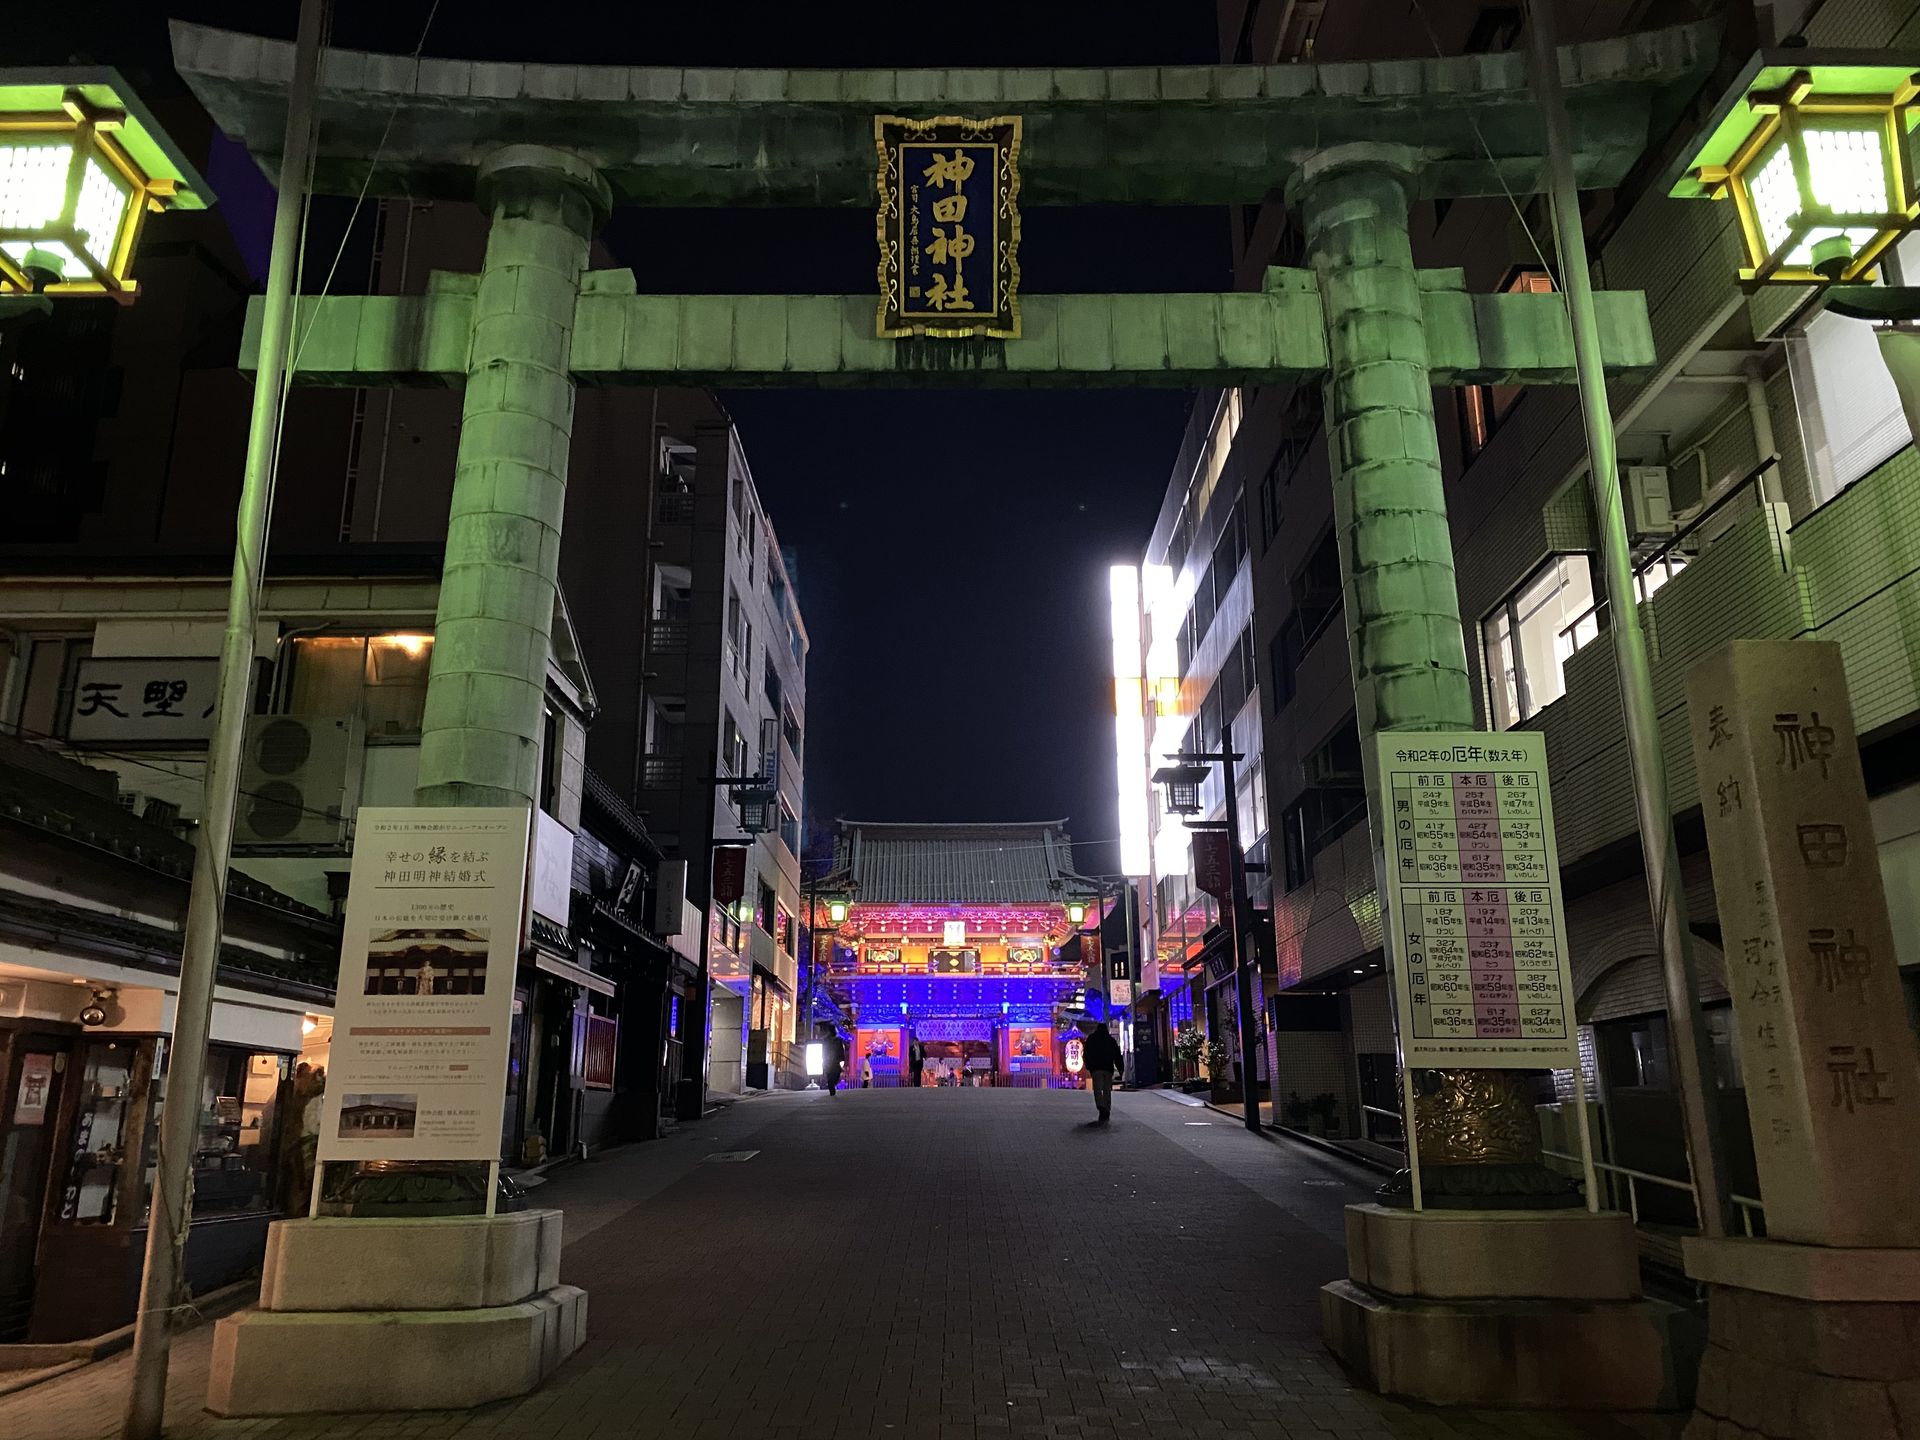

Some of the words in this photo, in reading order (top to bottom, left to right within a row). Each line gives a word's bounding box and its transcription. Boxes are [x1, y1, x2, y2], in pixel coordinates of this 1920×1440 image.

[924, 149, 975, 311] 神田神社
[78, 680, 215, 718] 天野
[1396, 746, 1528, 762] 令和2年の厄年(数え年)
[1418, 776, 1445, 786] 前厄
[1460, 776, 1487, 786] 本厄
[1502, 775, 1530, 785] 後厄
[1418, 800, 1450, 808] 平成9年生
[1460, 800, 1492, 808] 平成8年生
[1503, 799, 1534, 808] 平成7年生
[1397, 800, 1414, 869] 男の厄年
[1417, 831, 1455, 839] 昭和55年生
[1460, 831, 1498, 839] 昭和54年生
[1503, 831, 1540, 839] 昭和53年生
[386, 846, 489, 864] 幸せの縁を結ぶ
[1420, 863, 1458, 871] 昭和36年生
[1463, 863, 1501, 871] 昭和35年生
[1506, 863, 1544, 871] 昭和34年生
[384, 870, 486, 882] 神田明神結婚式
[1428, 891, 1456, 902] 前厄
[1472, 891, 1499, 902] 本厄
[1515, 891, 1542, 902] 後厄
[1772, 712, 1896, 1112] 神田神社
[1426, 917, 1463, 925] 平成15年生
[1470, 917, 1506, 925] 平成14年生
[1512, 917, 1550, 925] 平成13年生
[1472, 950, 1512, 958] 昭和63年生
[1515, 949, 1554, 958] 昭和62年生
[1409, 933, 1427, 1006] 女の厄年
[1431, 983, 1470, 991] 昭和60年生
[1474, 983, 1514, 991] 昭和59年生
[1519, 982, 1558, 991] 昭和58年生
[1434, 1017, 1473, 1026] 昭和36年生
[1478, 1017, 1517, 1026] 昭和35年生
[1522, 1017, 1562, 1026] 昭和34年生
